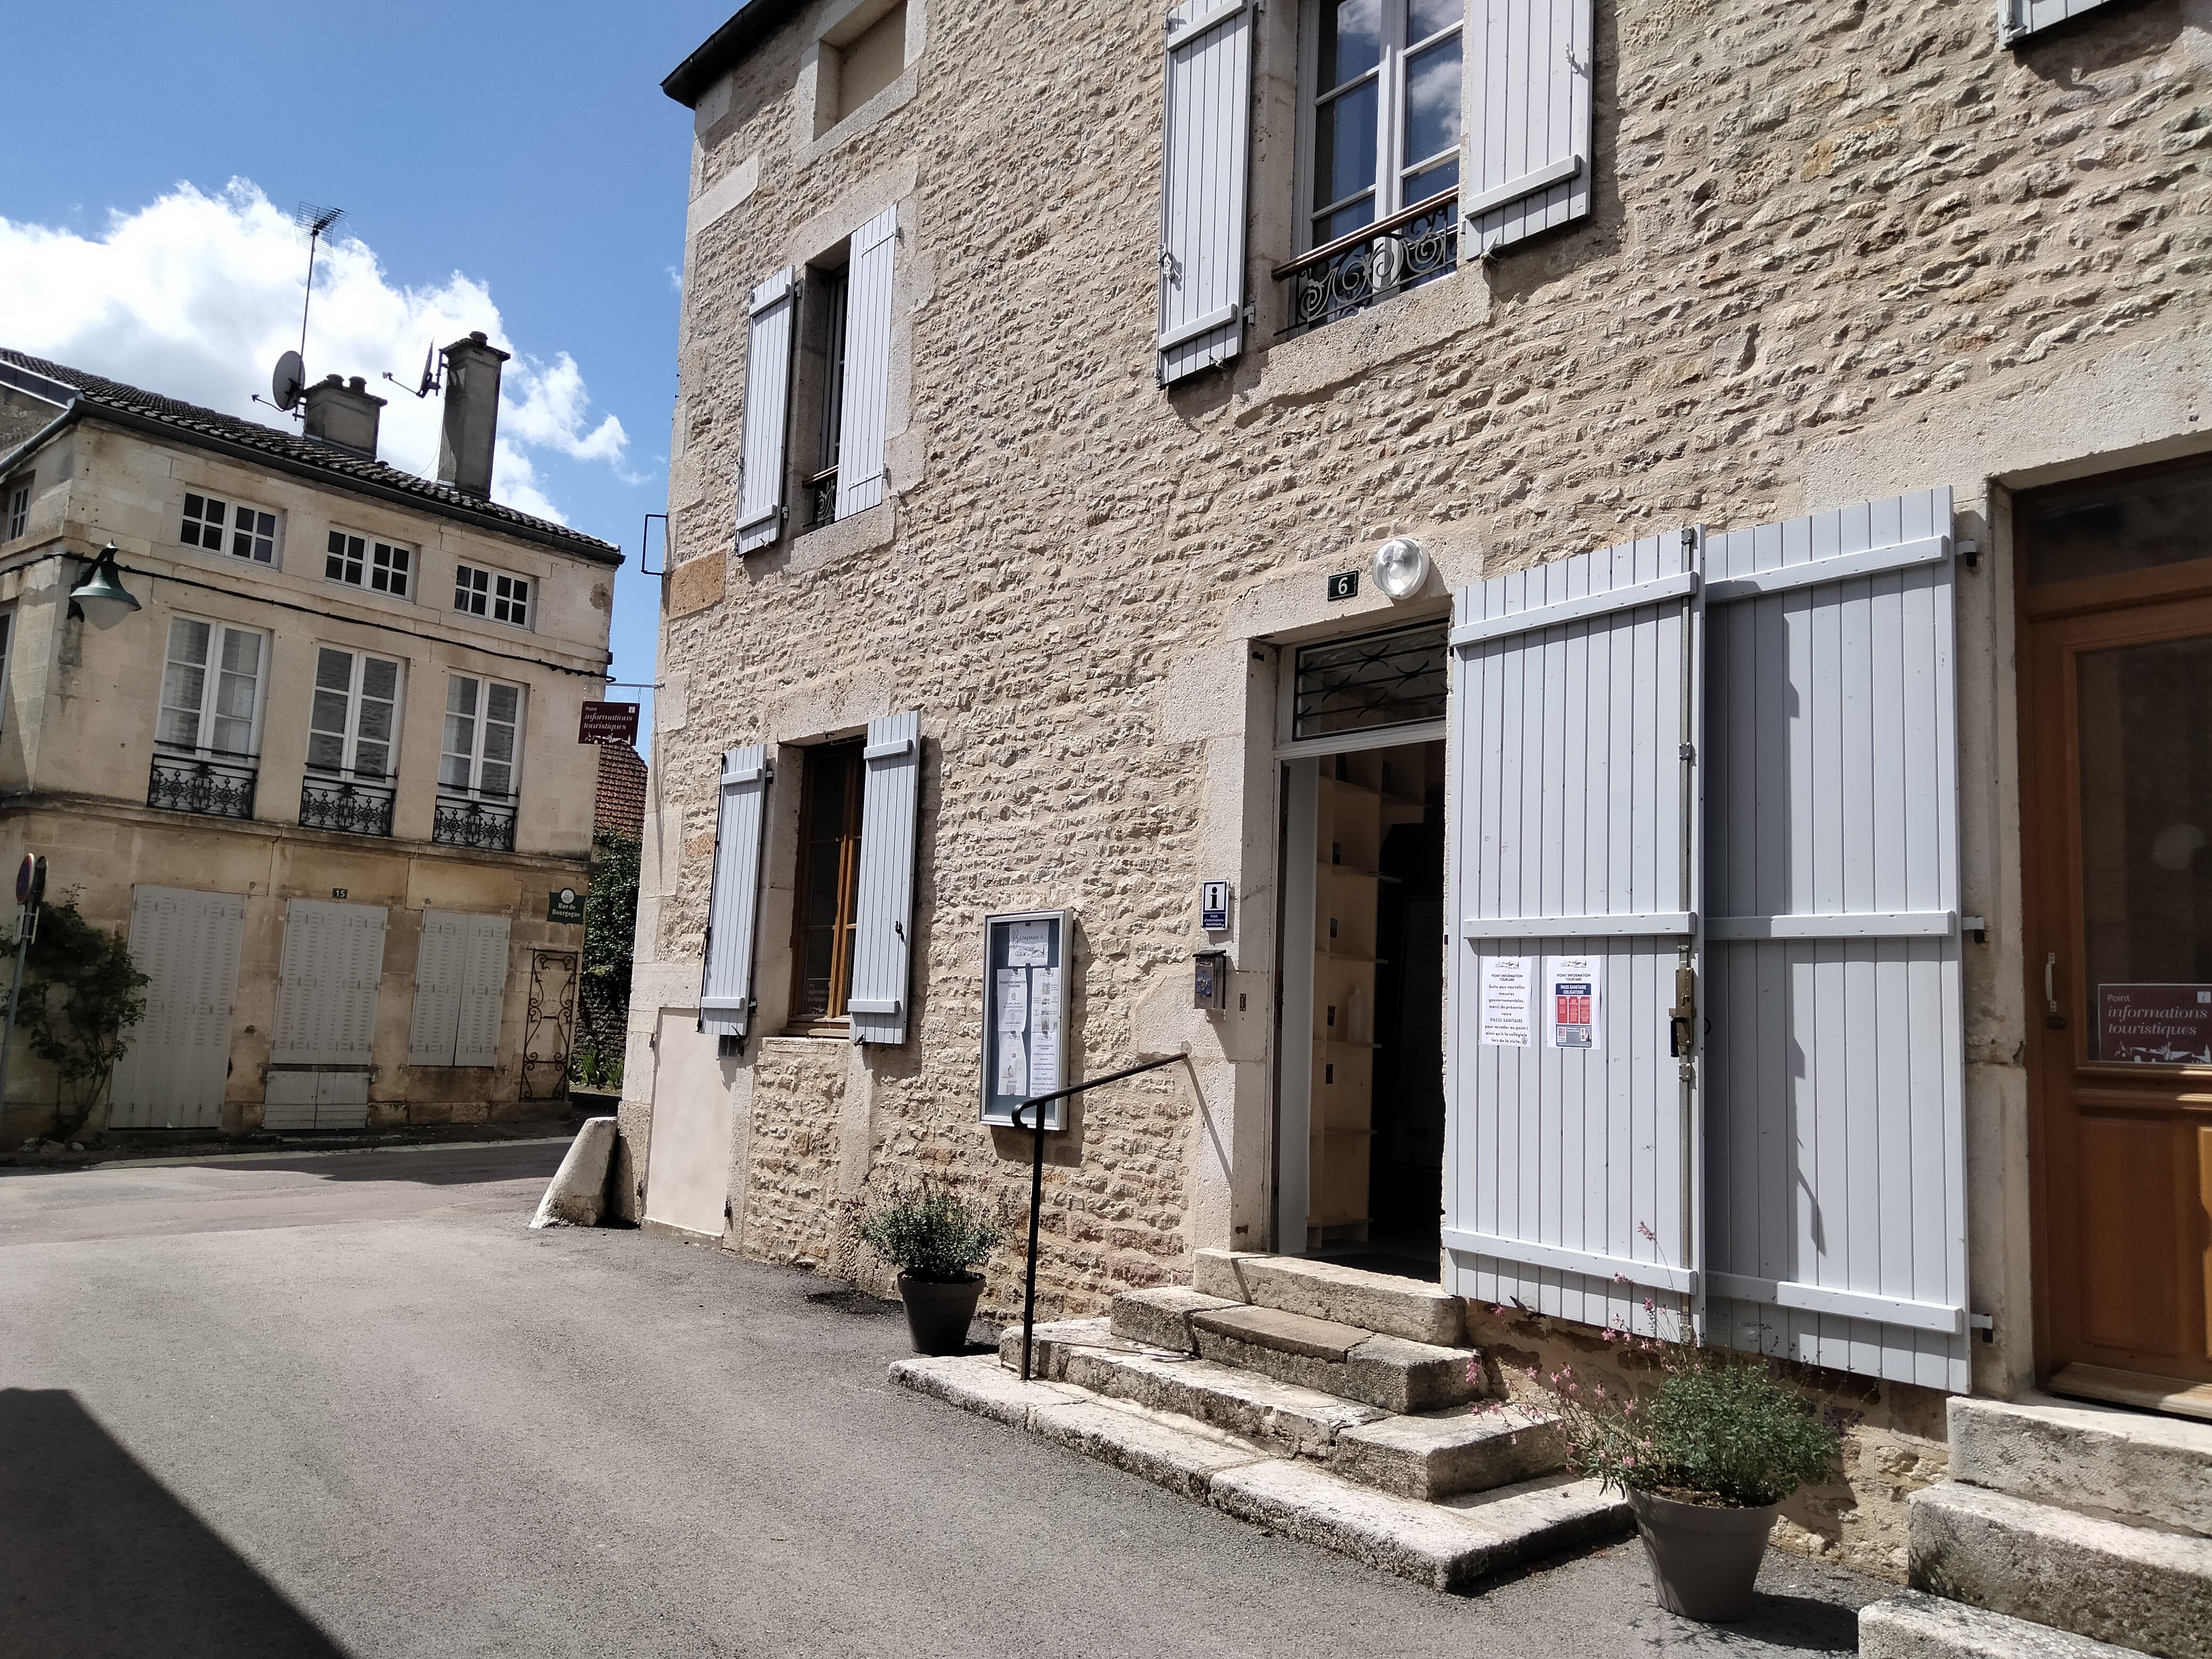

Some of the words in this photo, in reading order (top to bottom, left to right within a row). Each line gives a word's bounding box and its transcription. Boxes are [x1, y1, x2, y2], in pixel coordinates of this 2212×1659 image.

[1338, 577, 1348, 594] 6
[584, 713, 633, 722] informations
[583, 722, 626, 732] touristiques
[552, 909, 581, 918] Bourgogne
[2108, 1004, 2208, 1021] informations
[2108, 1022, 2197, 1038] touristiques
